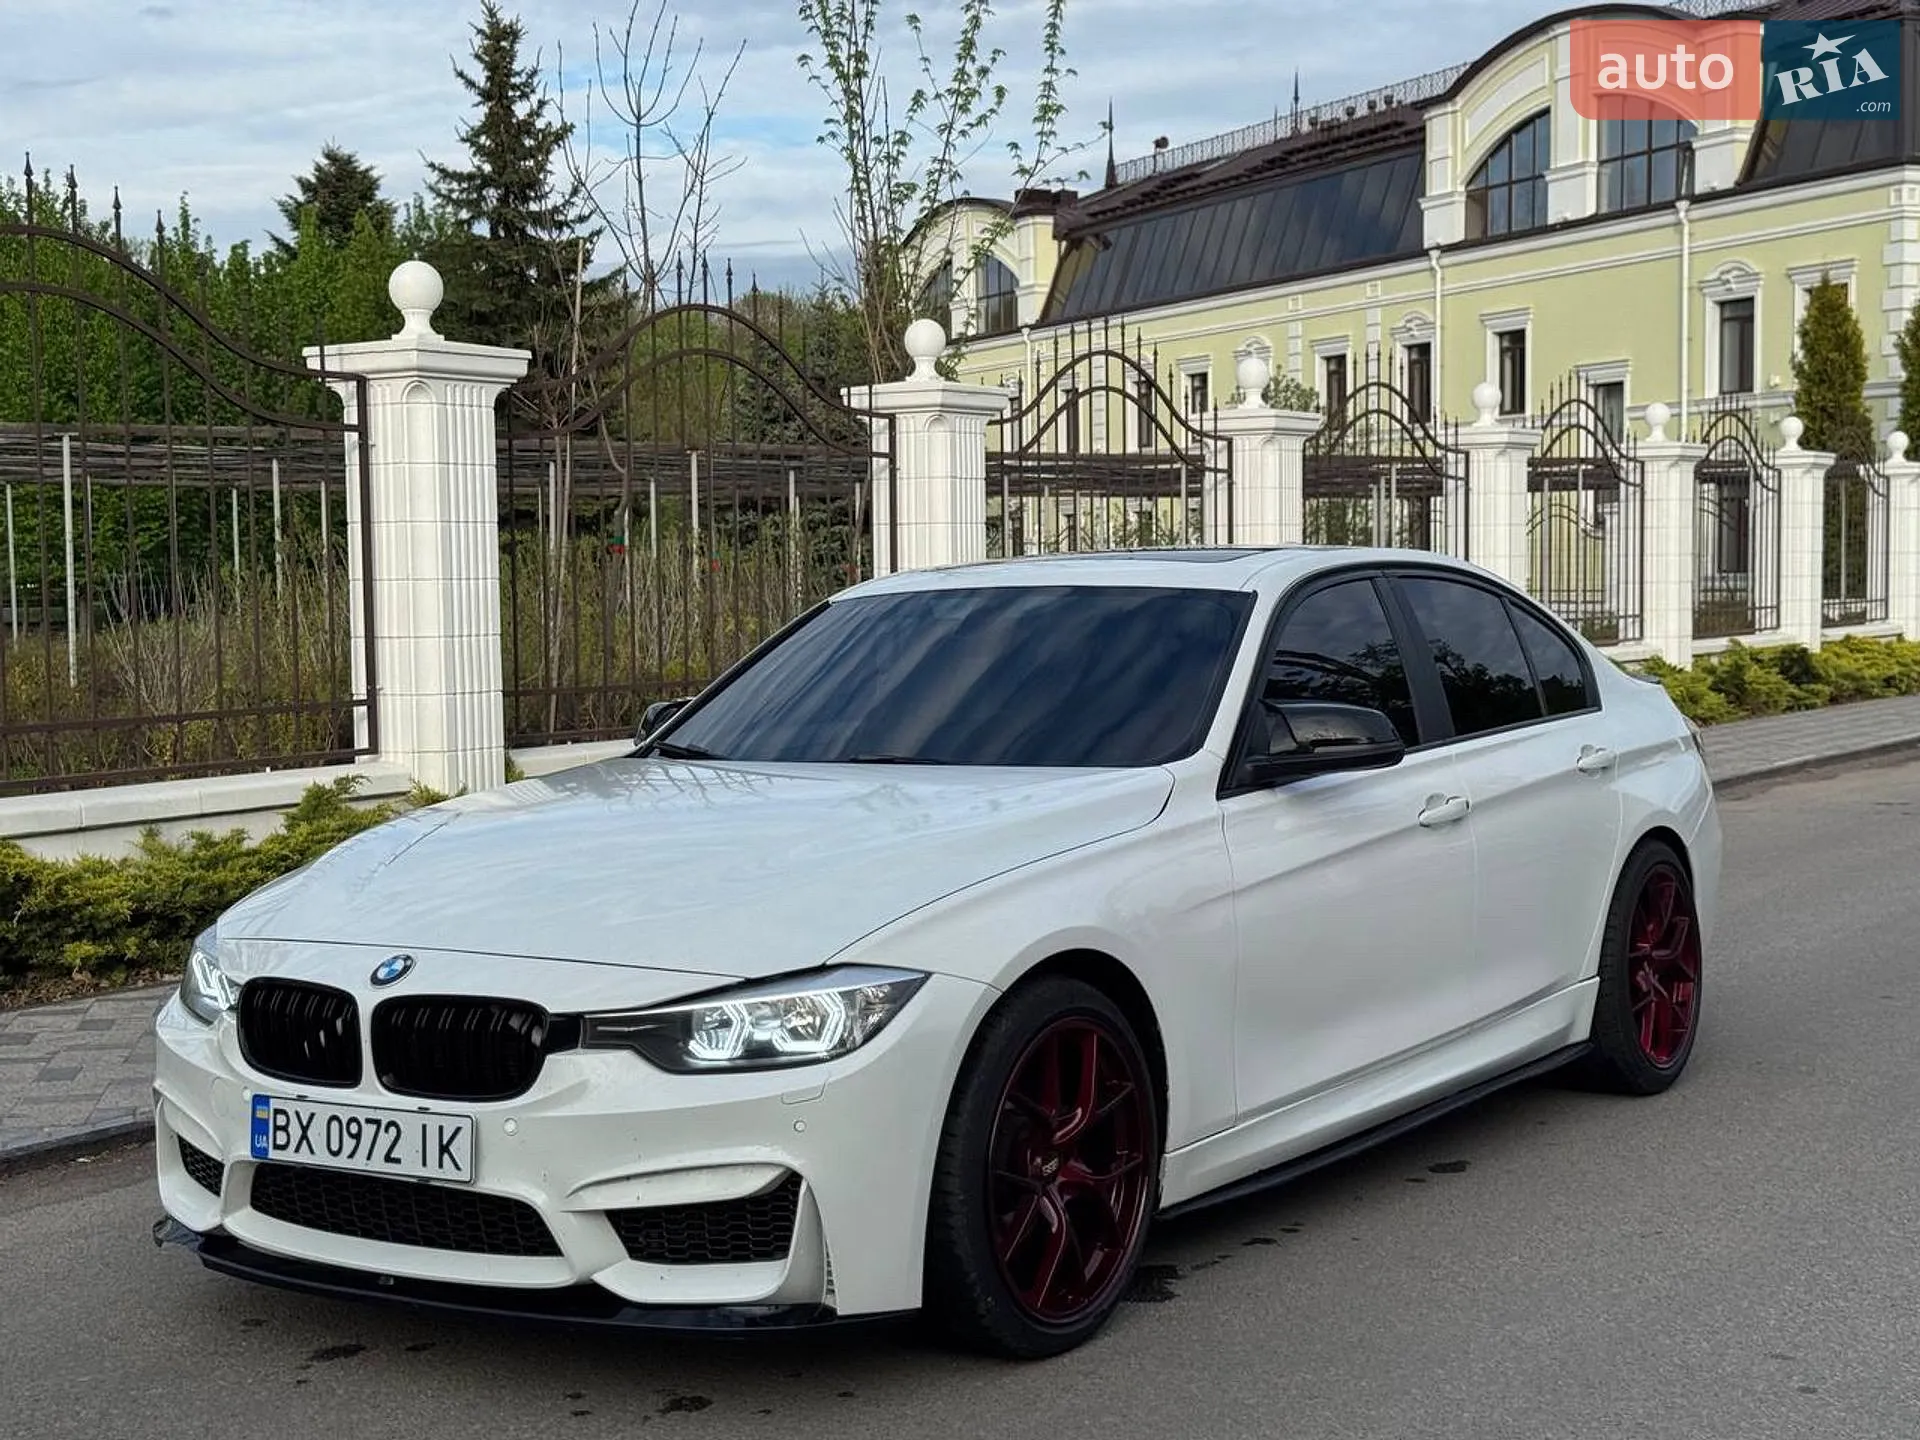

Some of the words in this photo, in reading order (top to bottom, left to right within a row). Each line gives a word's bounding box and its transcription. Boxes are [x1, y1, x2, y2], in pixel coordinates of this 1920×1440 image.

[255, 1134, 268, 1149] UA
[273, 1108, 315, 1155] BX
[326, 1114, 401, 1164] 0972
[421, 1123, 463, 1171] IK
